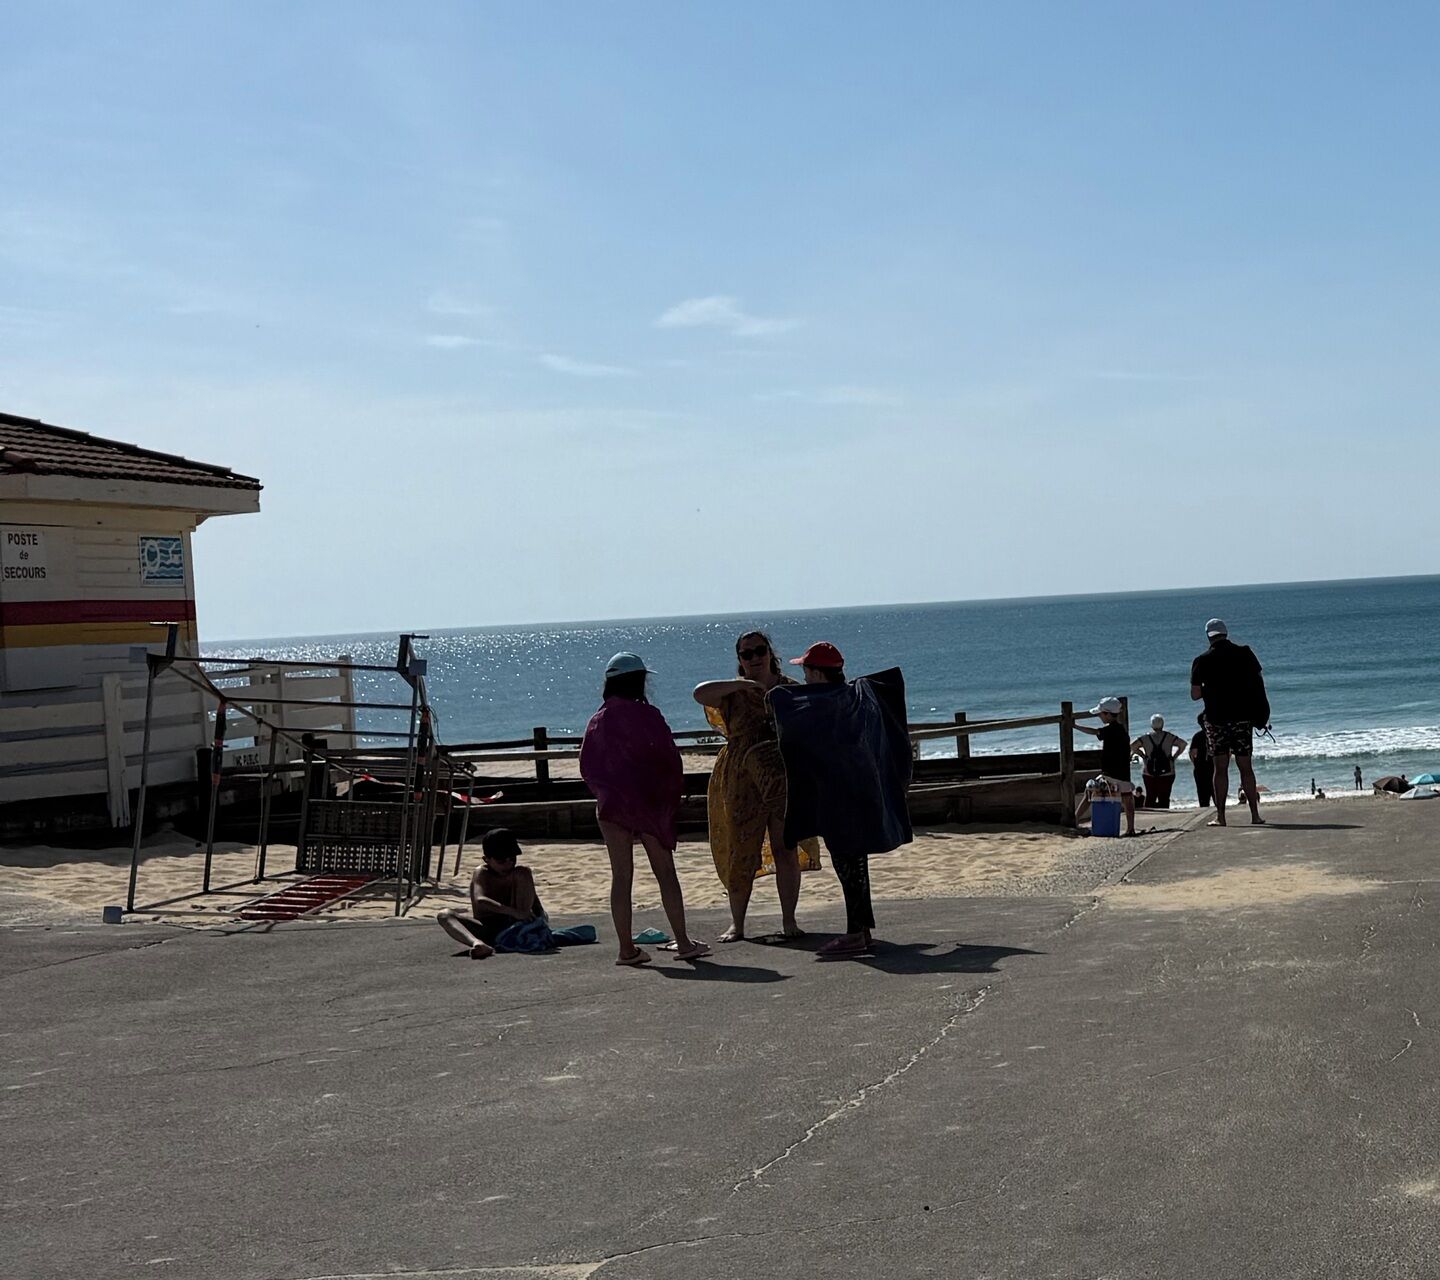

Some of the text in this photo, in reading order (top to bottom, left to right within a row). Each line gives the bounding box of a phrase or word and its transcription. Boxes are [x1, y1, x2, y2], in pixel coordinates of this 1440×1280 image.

[8, 533, 38, 546] POSTE
[19, 549, 29, 560] de
[4, 566, 46, 580] SECOURS
